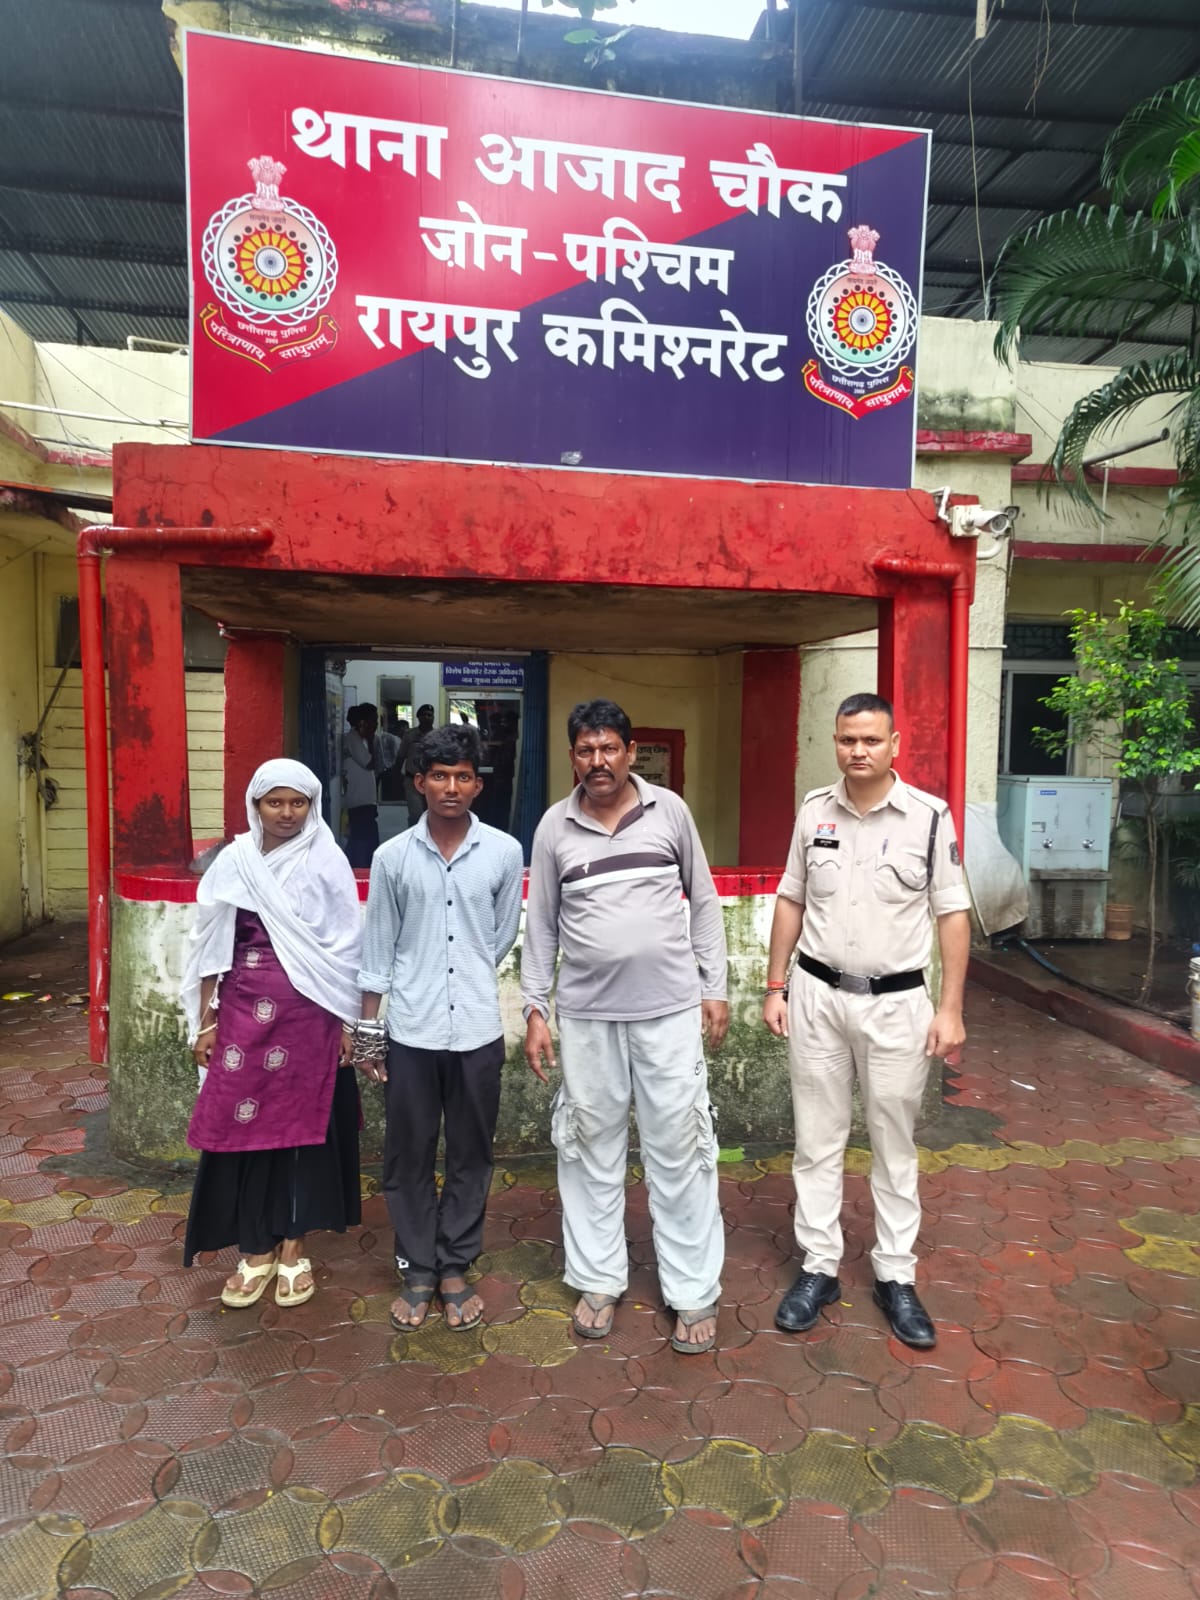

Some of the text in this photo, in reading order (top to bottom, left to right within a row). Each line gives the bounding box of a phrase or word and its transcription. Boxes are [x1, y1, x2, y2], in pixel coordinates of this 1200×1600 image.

[290, 106, 849, 224] थाना आजाद चौक
[355, 294, 789, 383] रायपुर कमिश्नरेट
